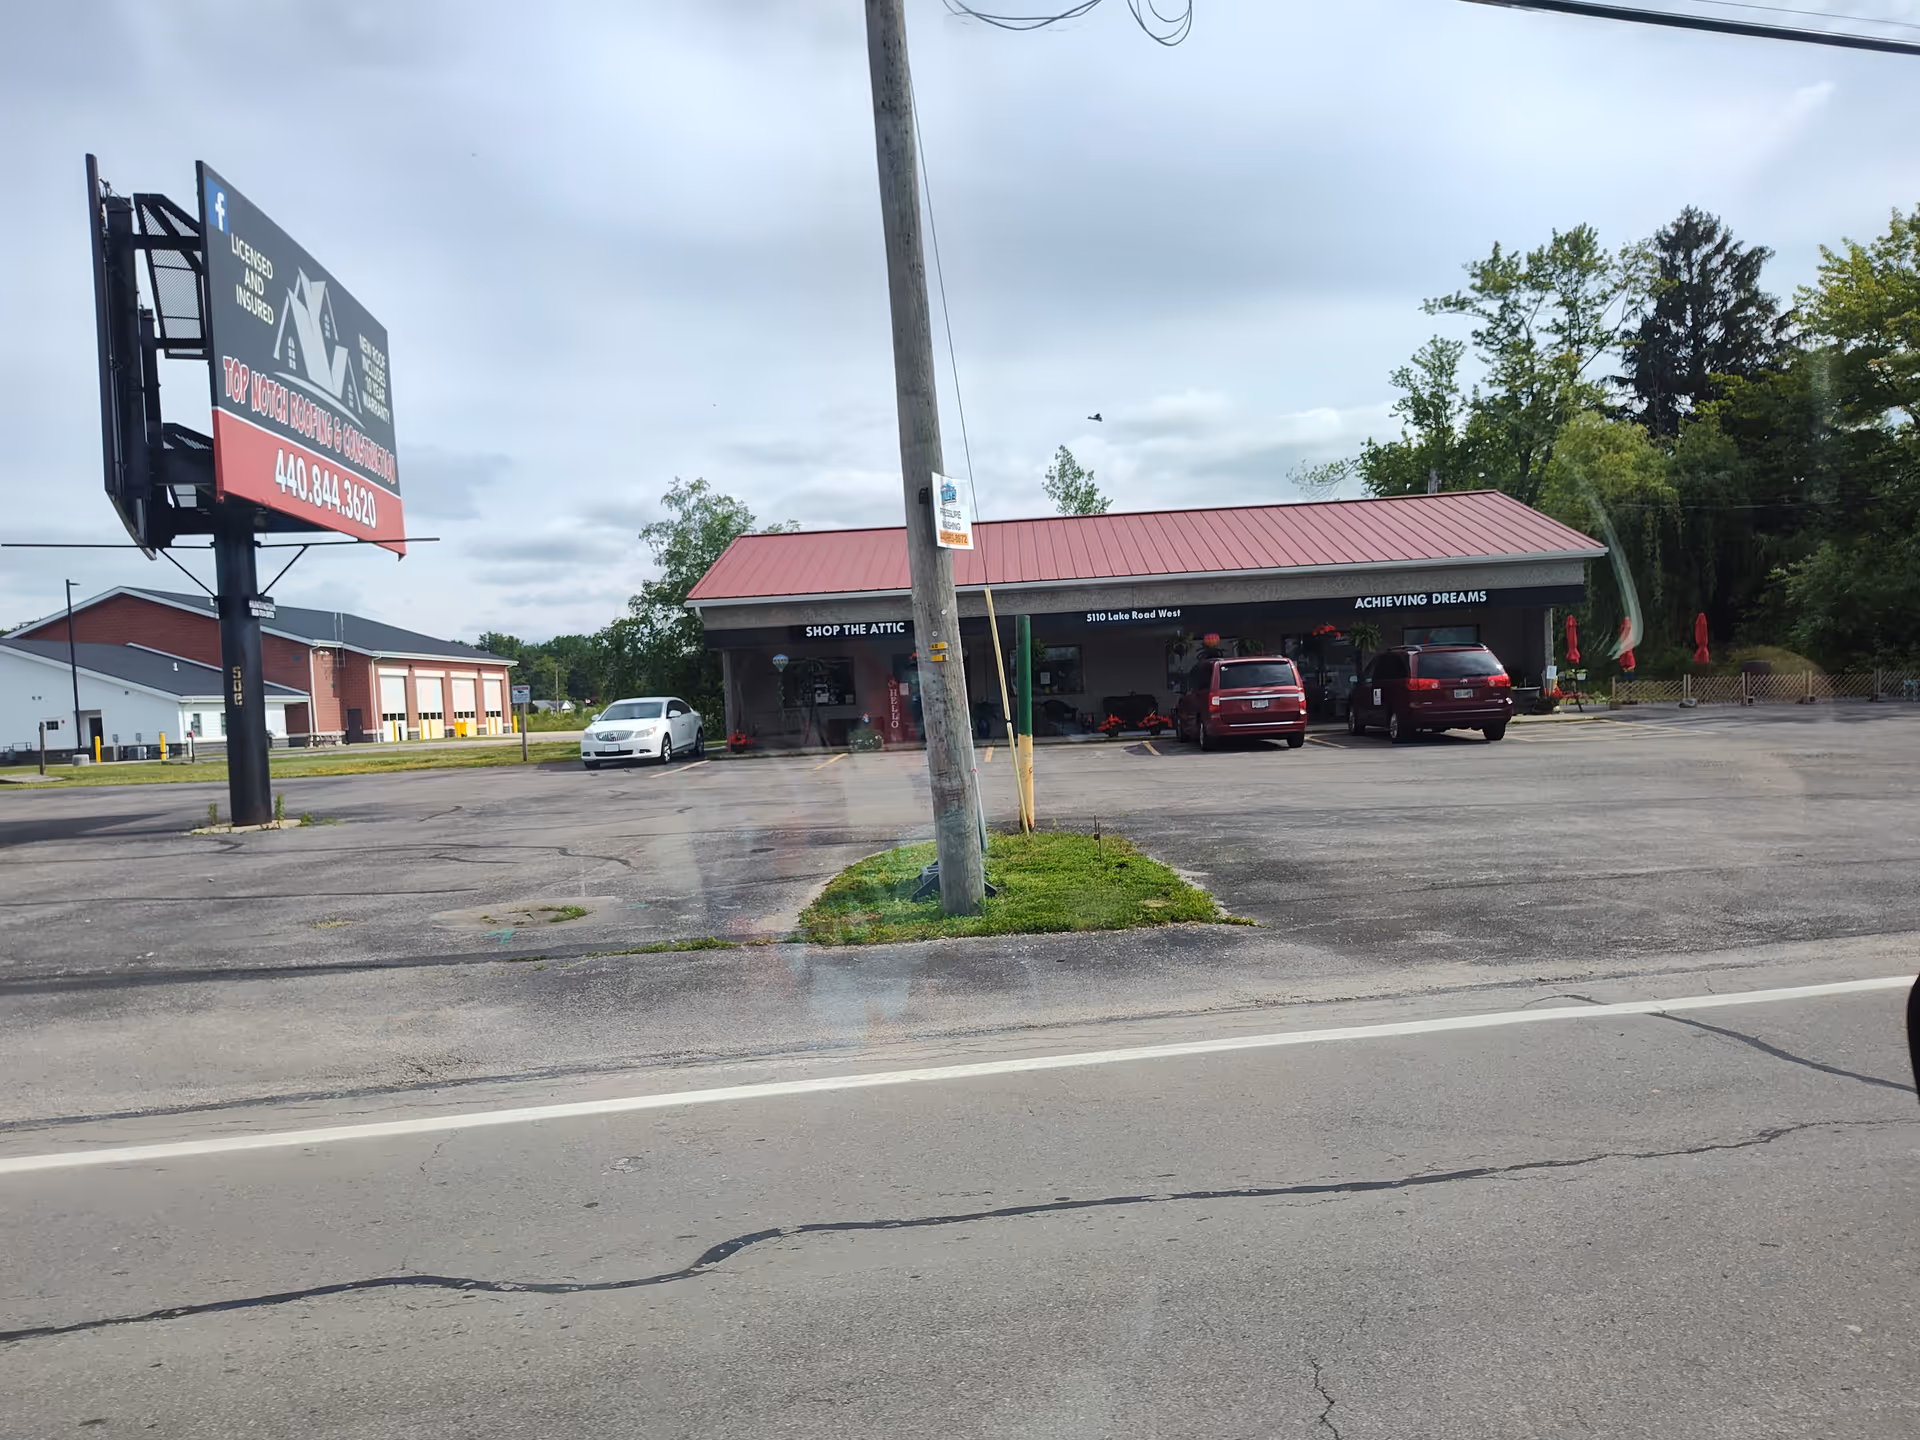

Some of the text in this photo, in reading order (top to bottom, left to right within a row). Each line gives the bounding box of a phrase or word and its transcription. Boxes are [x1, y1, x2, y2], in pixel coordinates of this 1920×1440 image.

[230, 232, 274, 280] LICENSED
[244, 267, 265, 297] AND
[235, 283, 274, 326] INSURED
[361, 353, 387, 389] INCLUDES
[222, 355, 397, 485] TOP NOTCH ROOFING & CONSTRUCTION
[362, 389, 391, 425] WARRANTY
[274, 448, 378, 529] 440.844.3620
[1086, 608, 1181, 622] 5110 Lake Road West
[1354, 590, 1487, 609] ACHIEVING DREAMS
[805, 622, 905, 637] SHOP THE ATTIC
[889, 688, 900, 729] HELLO
